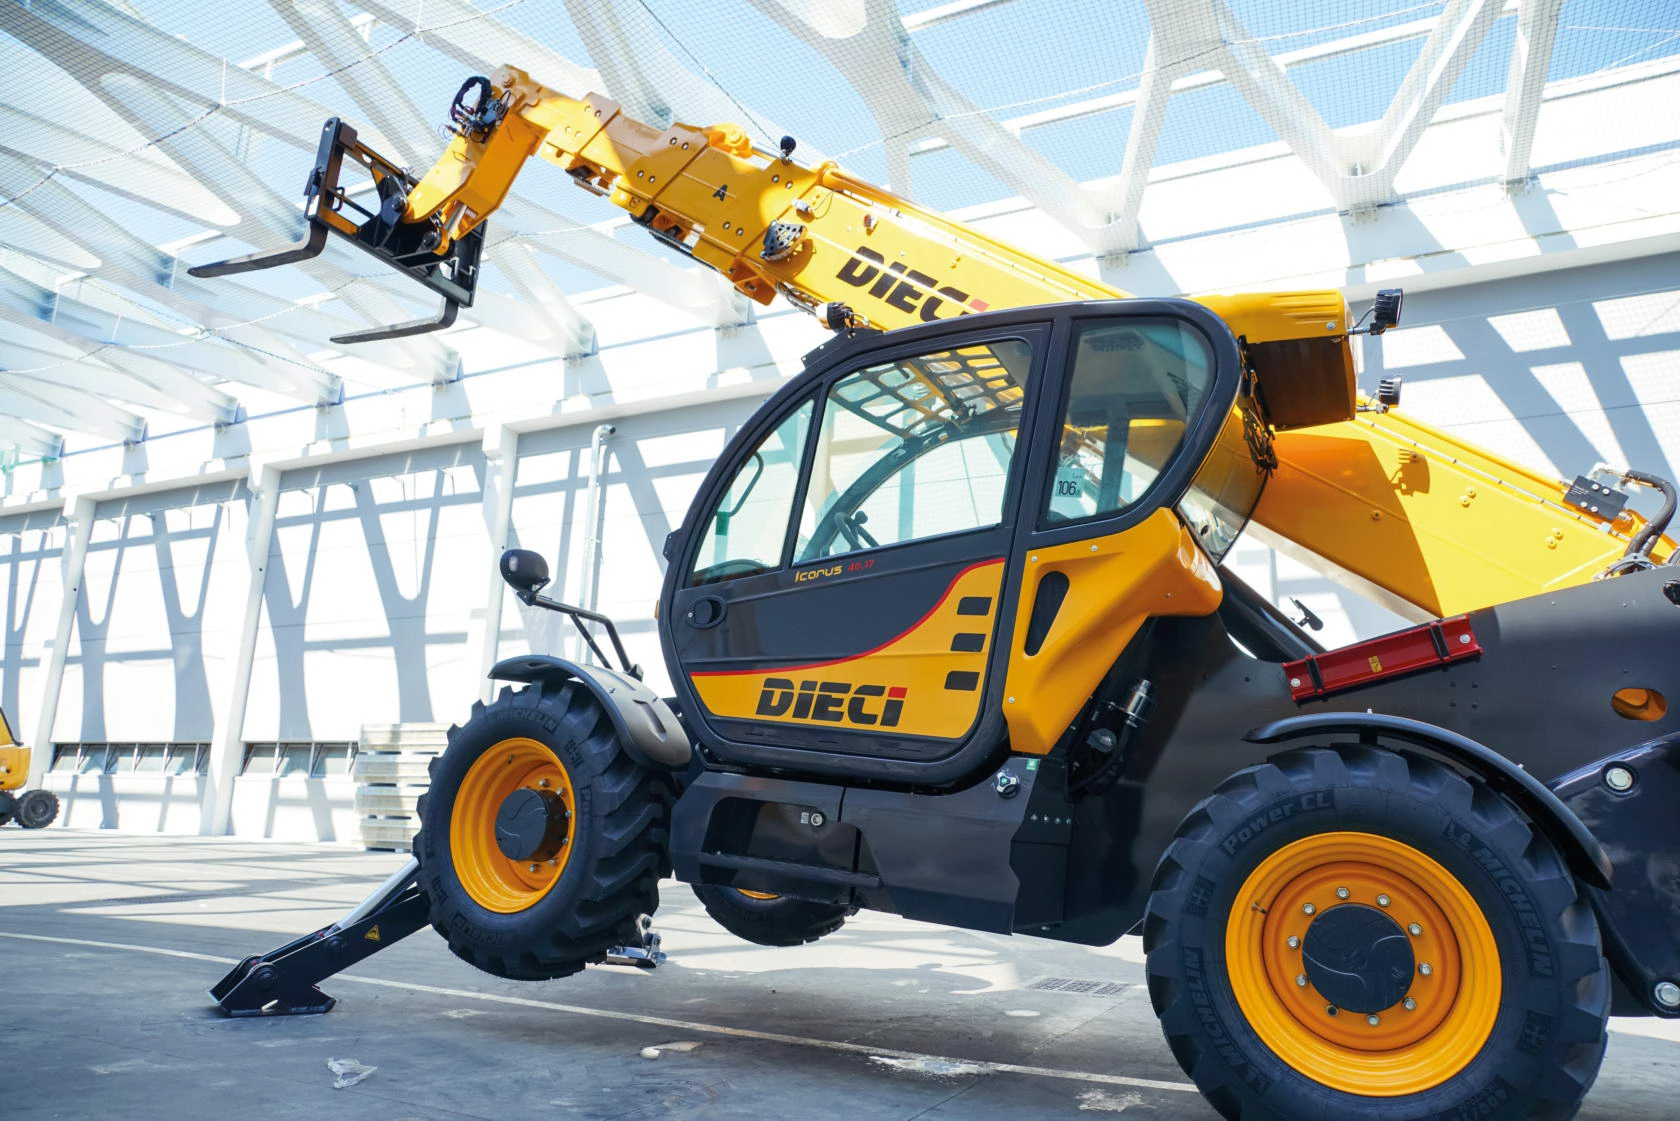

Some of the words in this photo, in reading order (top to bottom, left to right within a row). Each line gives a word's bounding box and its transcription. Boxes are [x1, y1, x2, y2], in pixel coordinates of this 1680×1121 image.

[712, 184, 728, 202] A
[1059, 481, 1077, 495] 106
[848, 560, 875, 571] 40.17
[1223, 803, 1294, 855] Power
[1301, 792, 1331, 810] CL
[1474, 845, 1553, 977] MICHELIN
[1183, 947, 1246, 1068] MICHELIN
